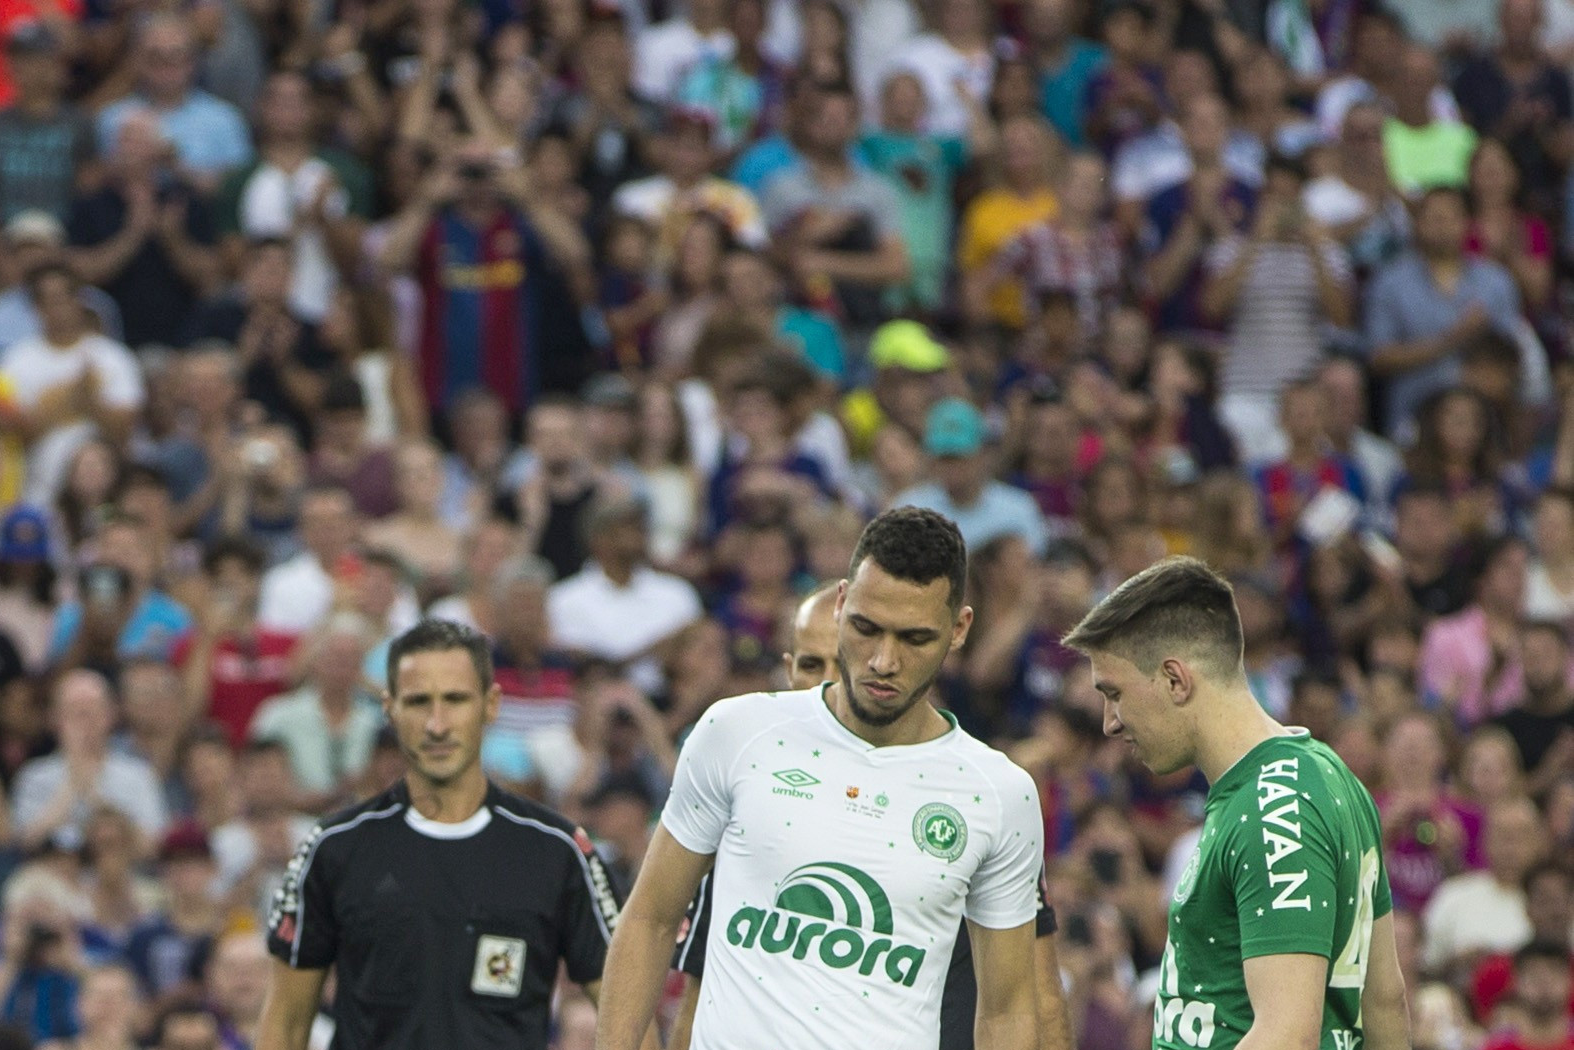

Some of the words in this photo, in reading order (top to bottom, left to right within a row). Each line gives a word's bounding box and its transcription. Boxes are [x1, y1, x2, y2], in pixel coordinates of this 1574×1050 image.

[772, 784, 815, 801] umbro
[1256, 756, 1313, 912] HAVAN
[726, 905, 927, 988] aurora
